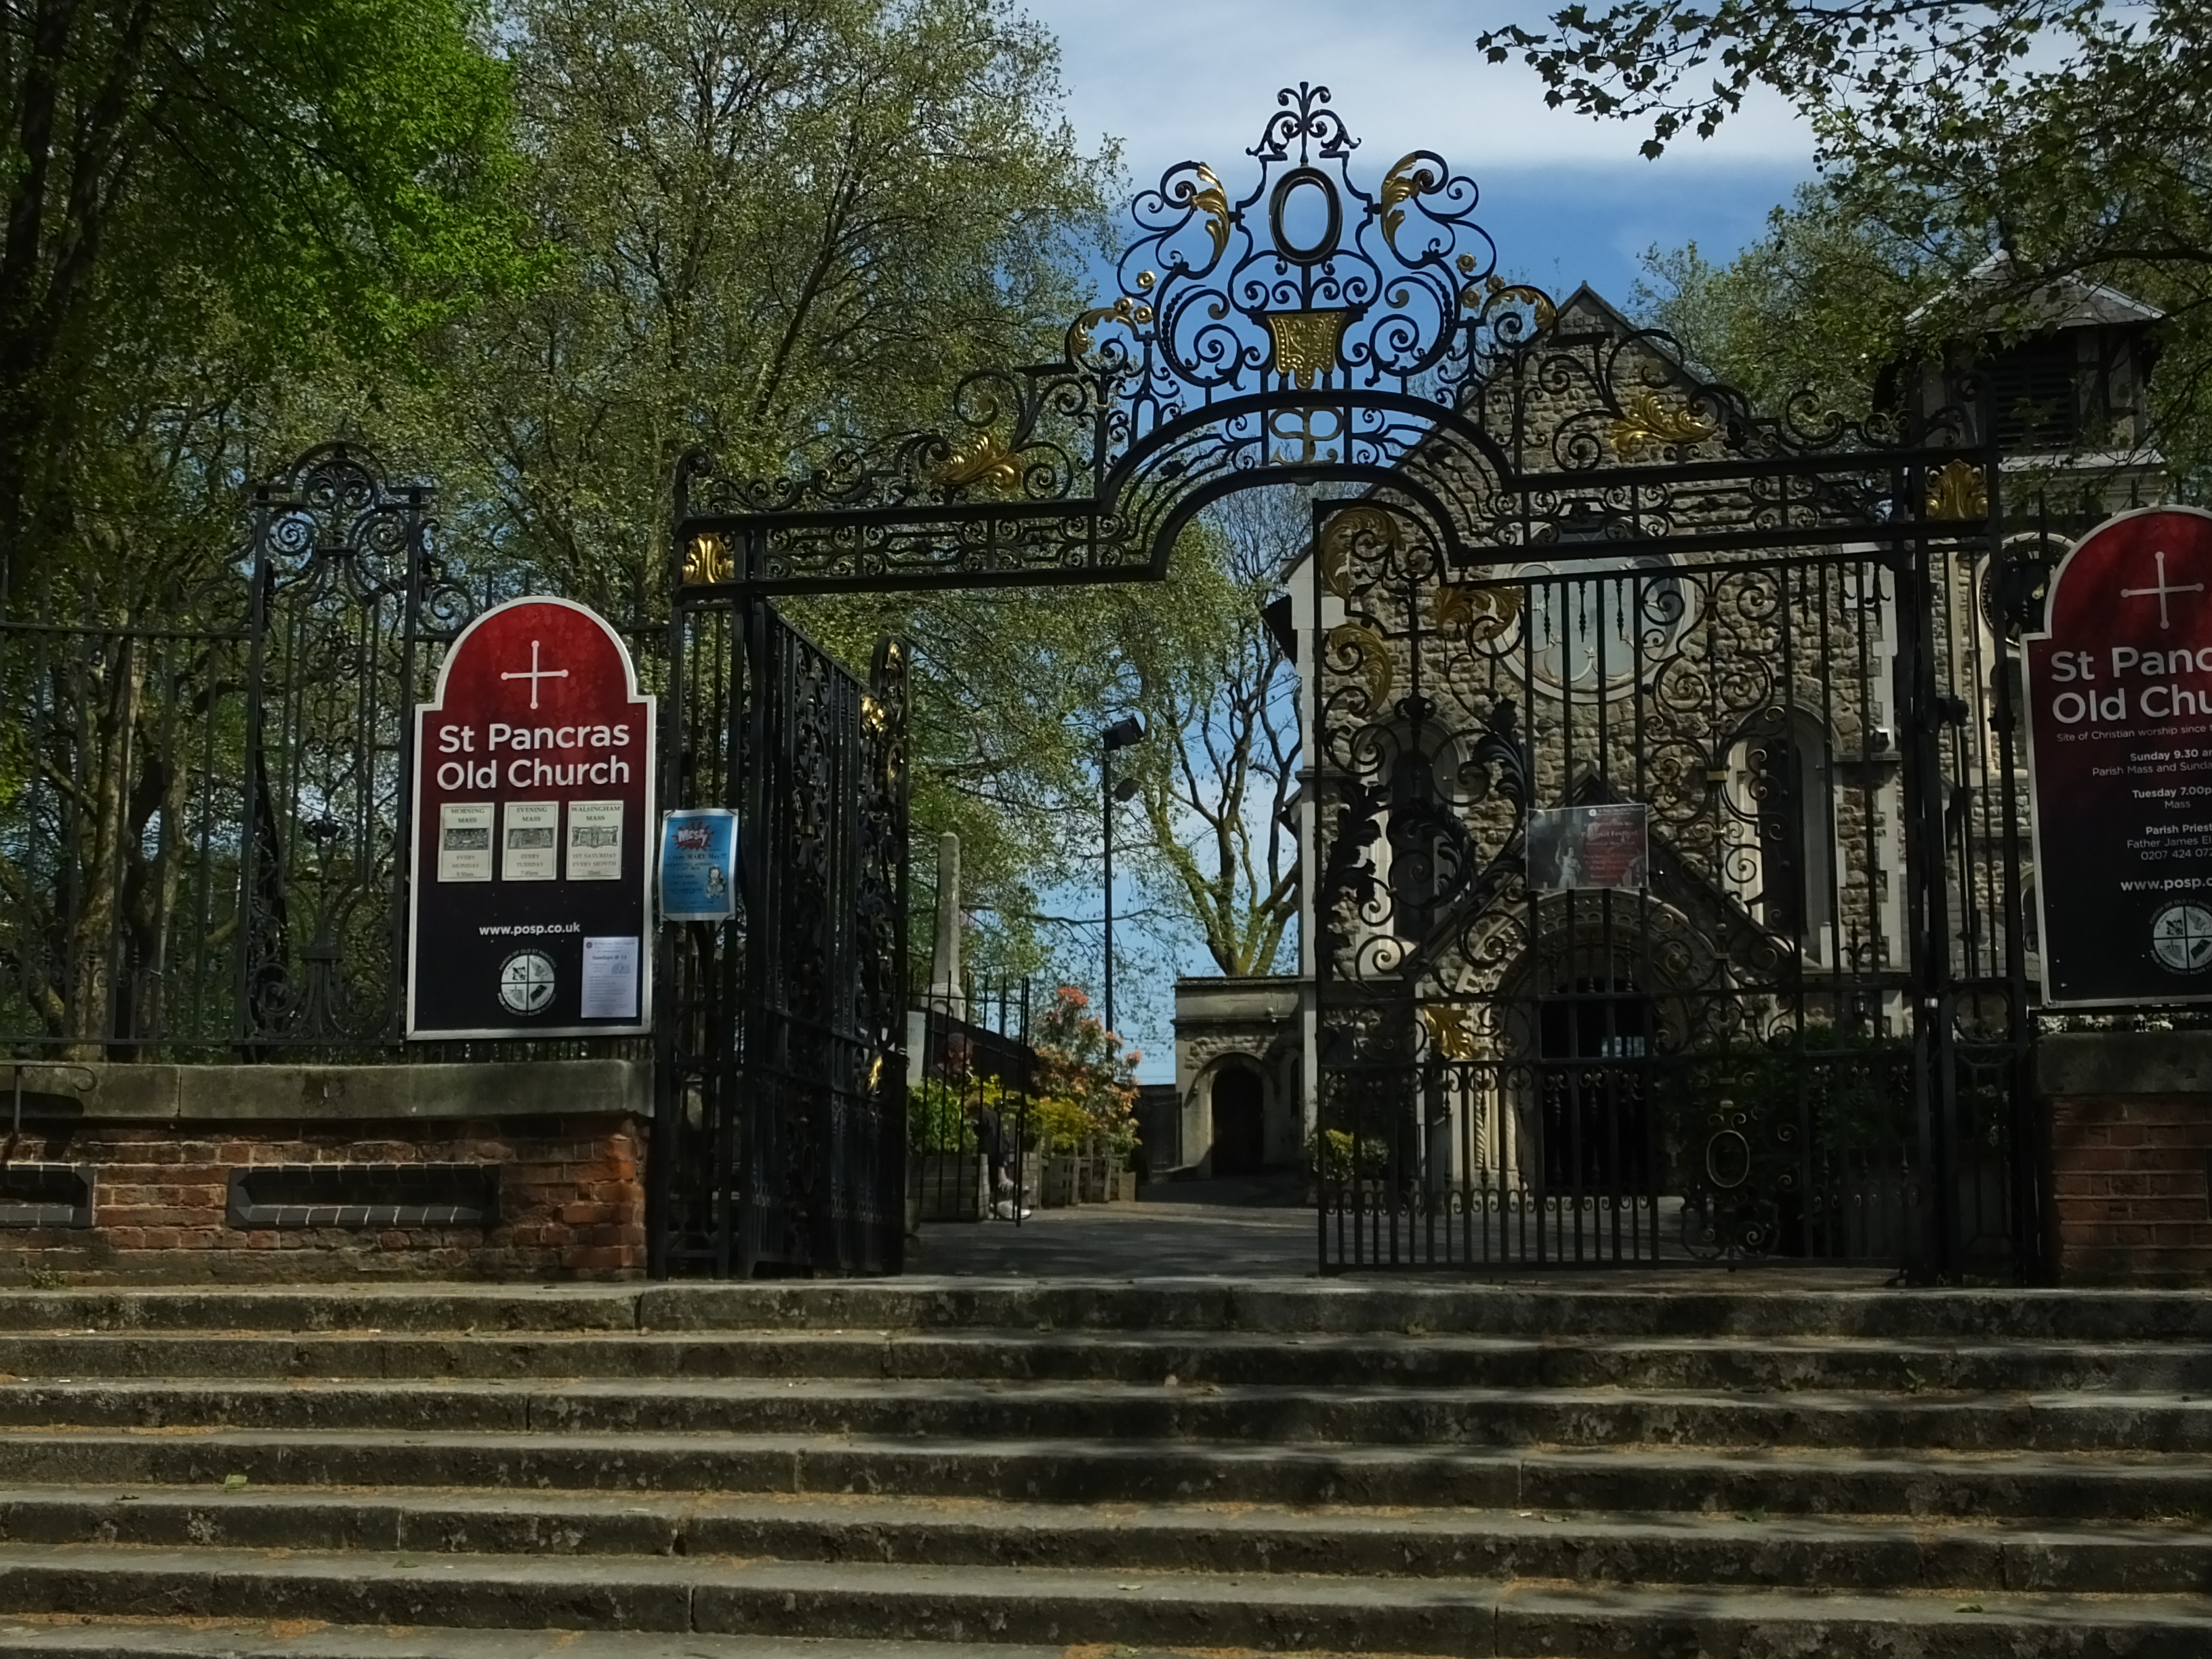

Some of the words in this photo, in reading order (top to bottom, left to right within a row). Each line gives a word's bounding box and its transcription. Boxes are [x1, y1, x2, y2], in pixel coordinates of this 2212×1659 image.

[2051, 651, 2095, 682] St
[2053, 688, 2127, 724] Old
[438, 725, 475, 753] St
[489, 723, 630, 751] Pancras
[2057, 733, 2075, 742] Site
[2078, 732, 2088, 741] of
[2091, 730, 2135, 740] Christian
[2138, 726, 2177, 737] worship
[2181, 725, 2207, 734] since
[2130, 751, 2170, 762] Sunday
[2173, 749, 2198, 759] 9.30
[436, 759, 497, 790] Old
[508, 755, 630, 787] Church
[2092, 766, 2124, 777] Parish
[2127, 766, 2153, 774] Mass
[2156, 763, 2176, 773] and
[2132, 788, 2177, 798] Tuesday
[2180, 786, 2212, 796] 7.00p
[2165, 800, 2191, 809] Mass
[2146, 825, 2179, 835] Parish
[2182, 823, 2212, 834] Priest
[2127, 839, 2160, 849] Father
[2165, 837, 2198, 846] James
[2141, 851, 2168, 861] 0207
[2172, 849, 2192, 859] 424
[2121, 876, 2212, 893] www.posp.c
[478, 922, 581, 937] www.posp.co.uk
